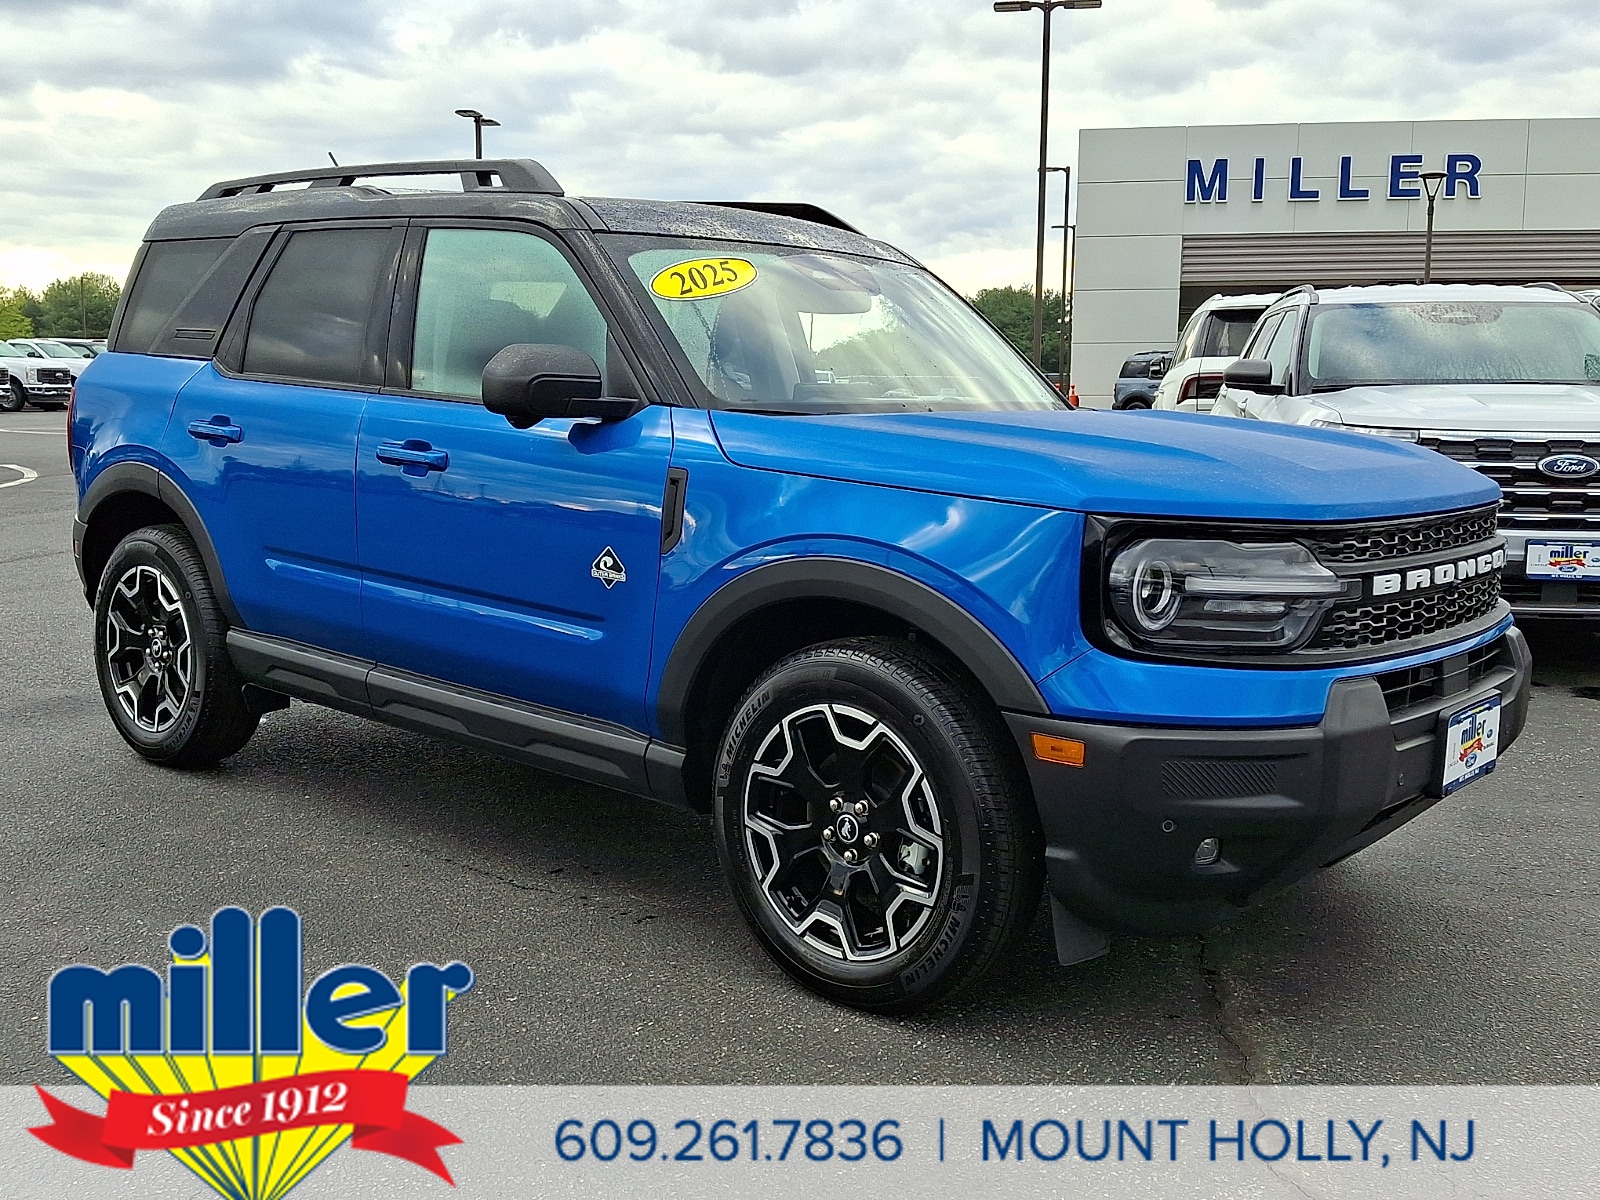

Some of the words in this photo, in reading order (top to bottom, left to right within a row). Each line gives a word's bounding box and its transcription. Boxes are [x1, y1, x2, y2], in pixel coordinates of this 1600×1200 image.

[1186, 154, 1482, 202] MILLER
[670, 260, 738, 296] 2025
[1553, 459, 1587, 472] Ford
[1372, 549, 1504, 596] BRONCO
[1549, 545, 1590, 559] miller
[725, 689, 772, 758] MICHELIN
[1460, 714, 1487, 746] miller
[904, 915, 961, 986] MICHELIN
